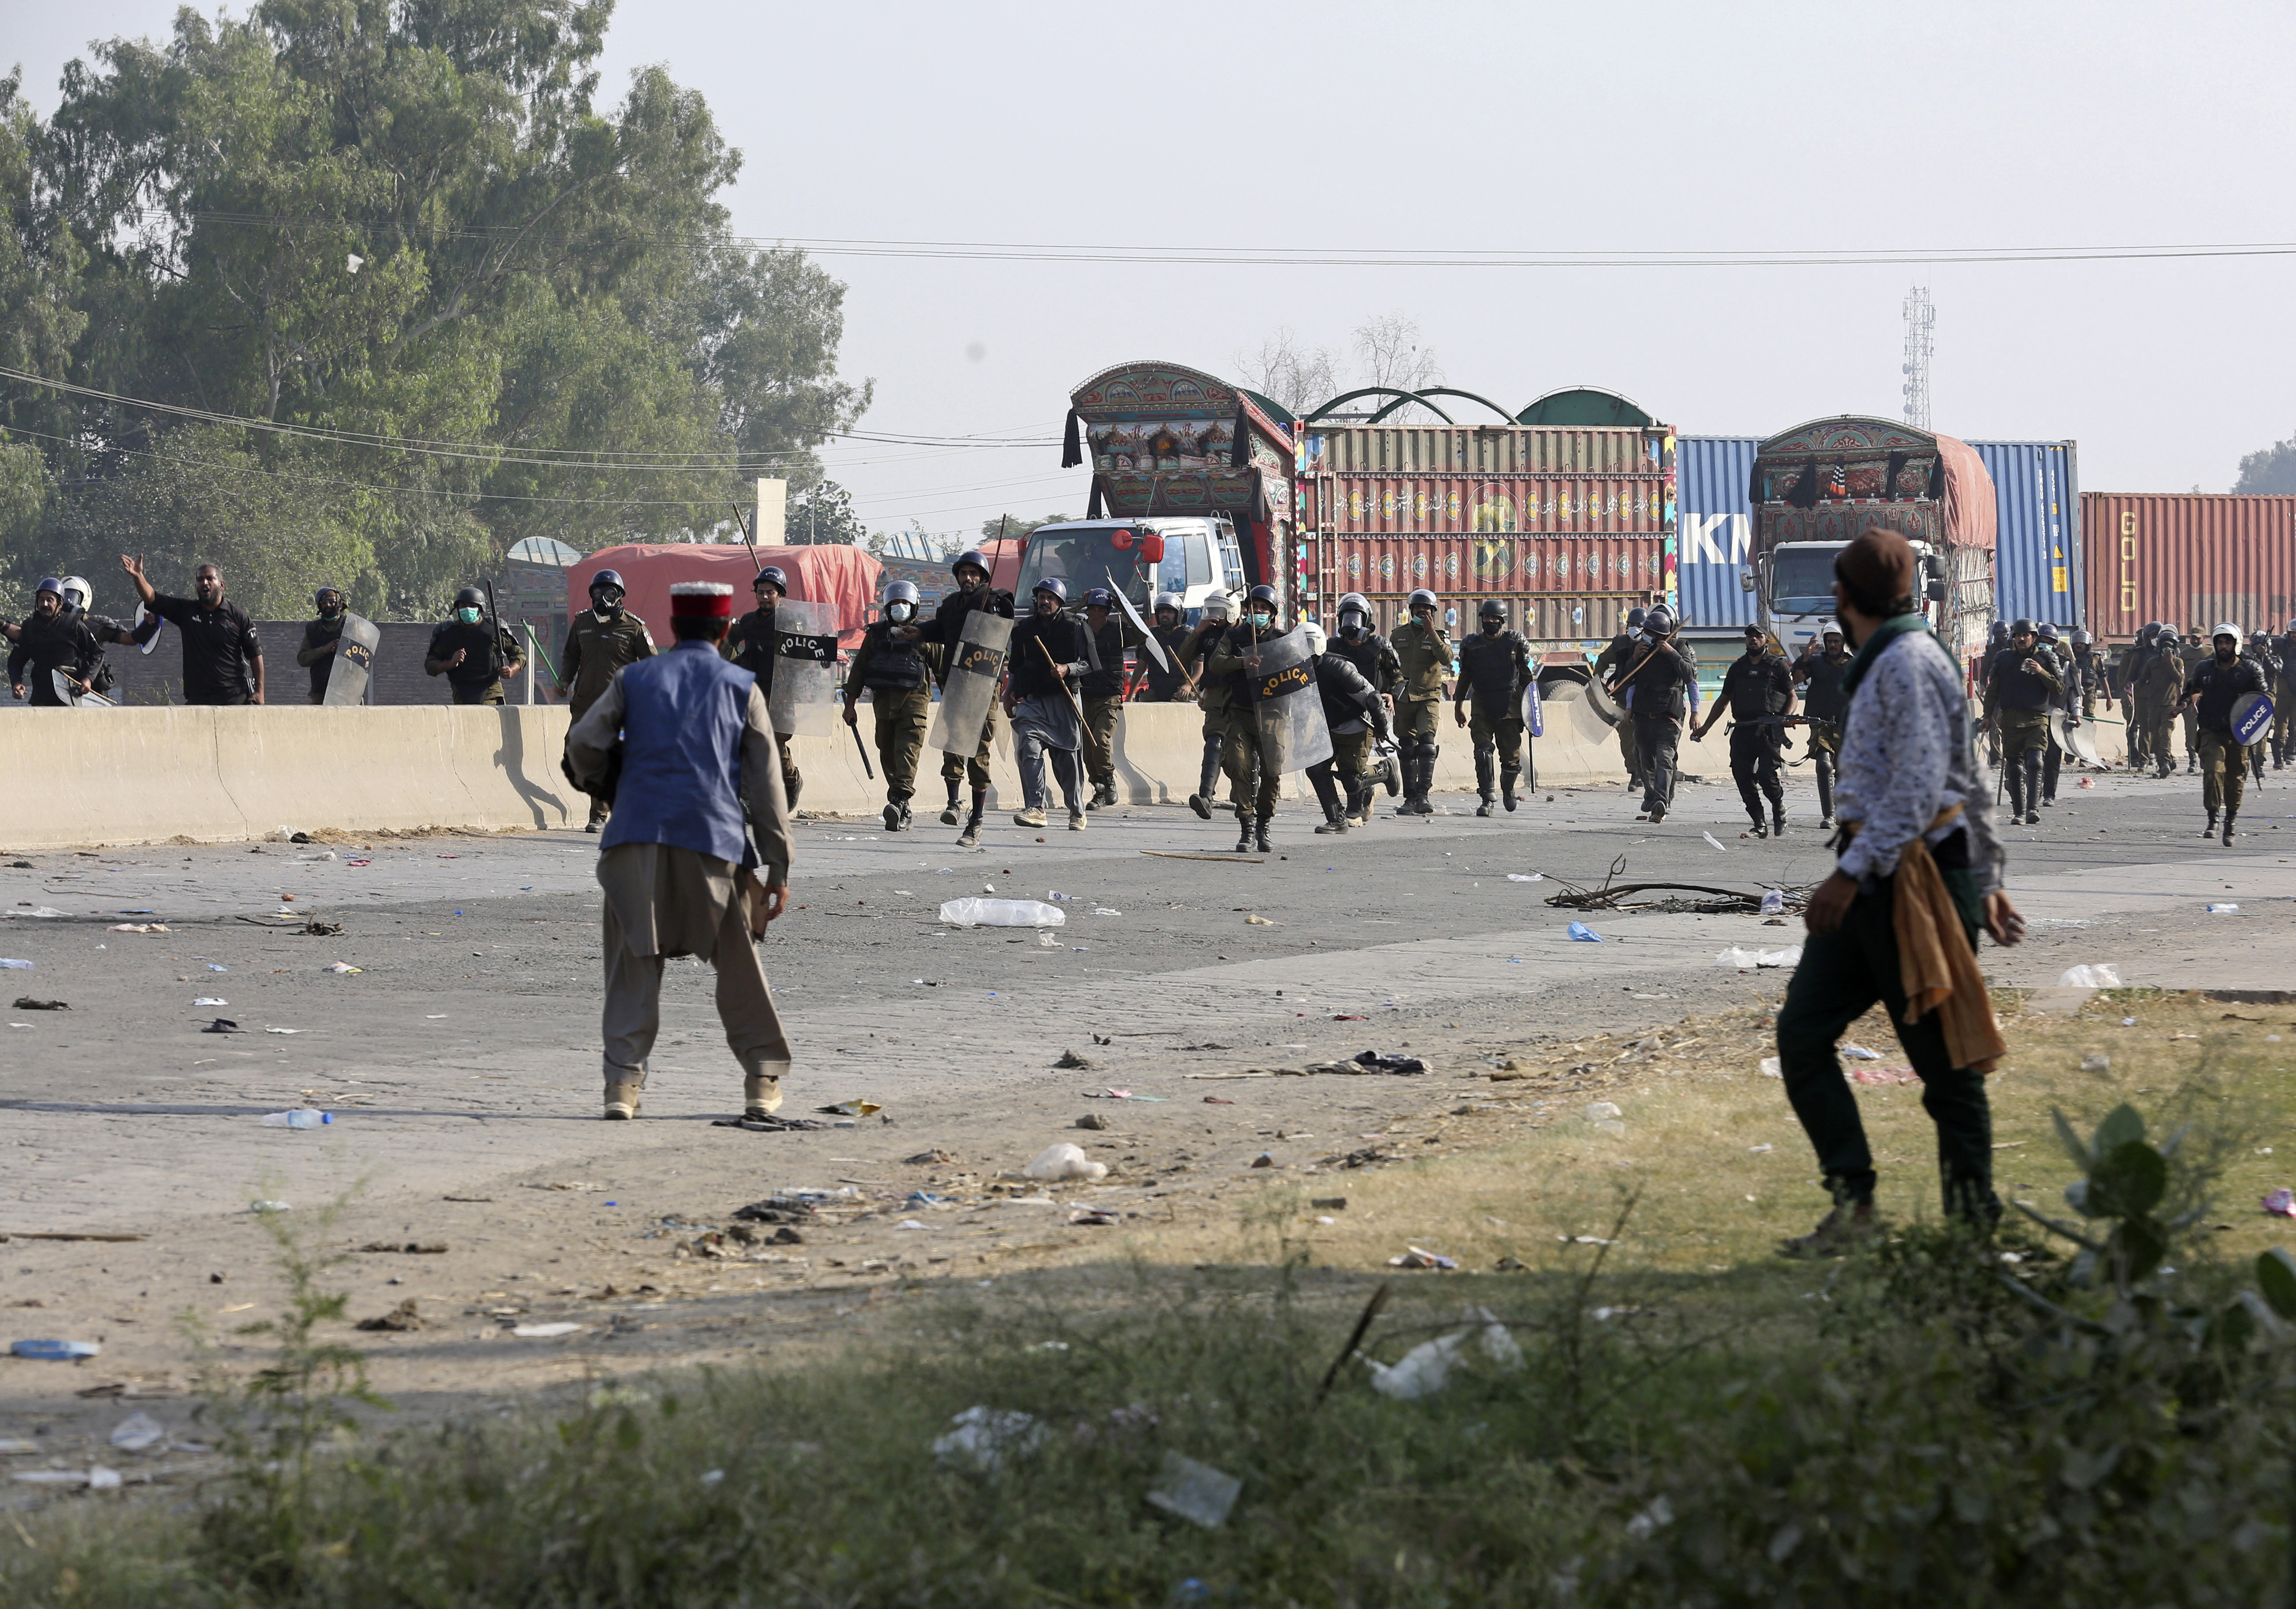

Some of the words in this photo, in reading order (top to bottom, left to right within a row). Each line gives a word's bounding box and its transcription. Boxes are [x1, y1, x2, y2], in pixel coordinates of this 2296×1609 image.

[2122, 511, 2136, 611] GOLD
[781, 637, 825, 658] POLICE
[1262, 668, 1309, 695] POLICE
[2241, 705, 2267, 735] POLICE
